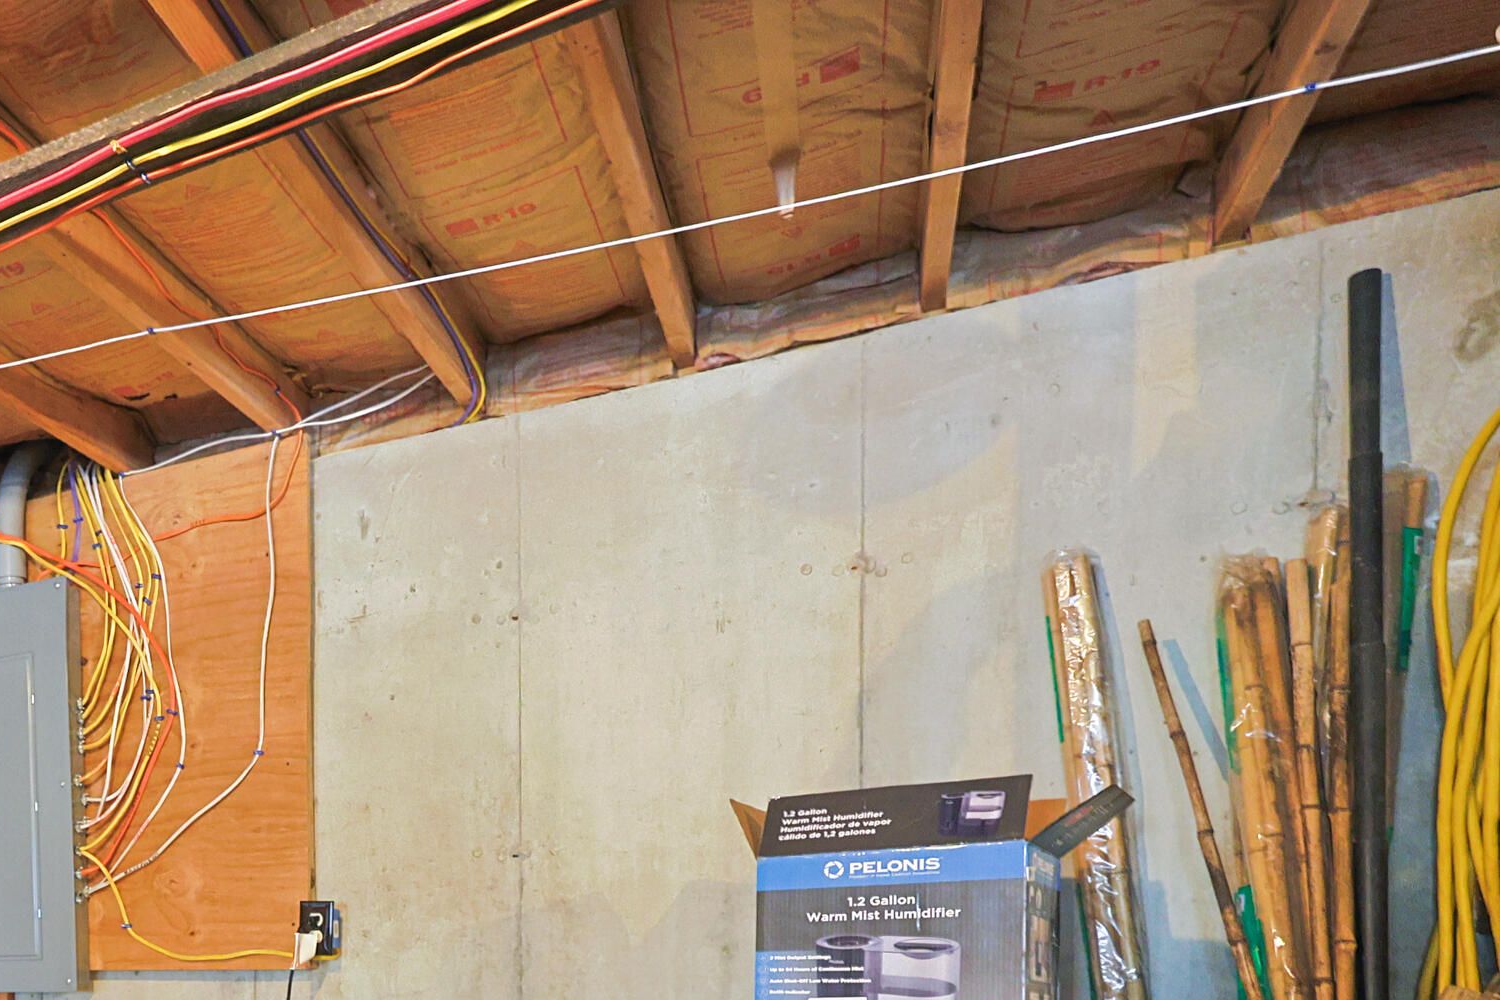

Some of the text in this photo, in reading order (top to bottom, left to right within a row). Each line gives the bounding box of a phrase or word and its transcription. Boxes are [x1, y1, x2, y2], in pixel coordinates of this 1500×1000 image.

[782, 811, 884, 825] Warm Mist Humidifier
[798, 808, 828, 816] Gallon
[780, 818, 892, 834] Humidificador de vapor
[778, 832, 807, 841] cálido
[809, 831, 821, 839] de
[838, 828, 876, 838] galones
[849, 857, 941, 874] PELONIS
[847, 894, 916, 907] 1.2 Gallon
[806, 907, 962, 923] Warm Mist Humidifier
